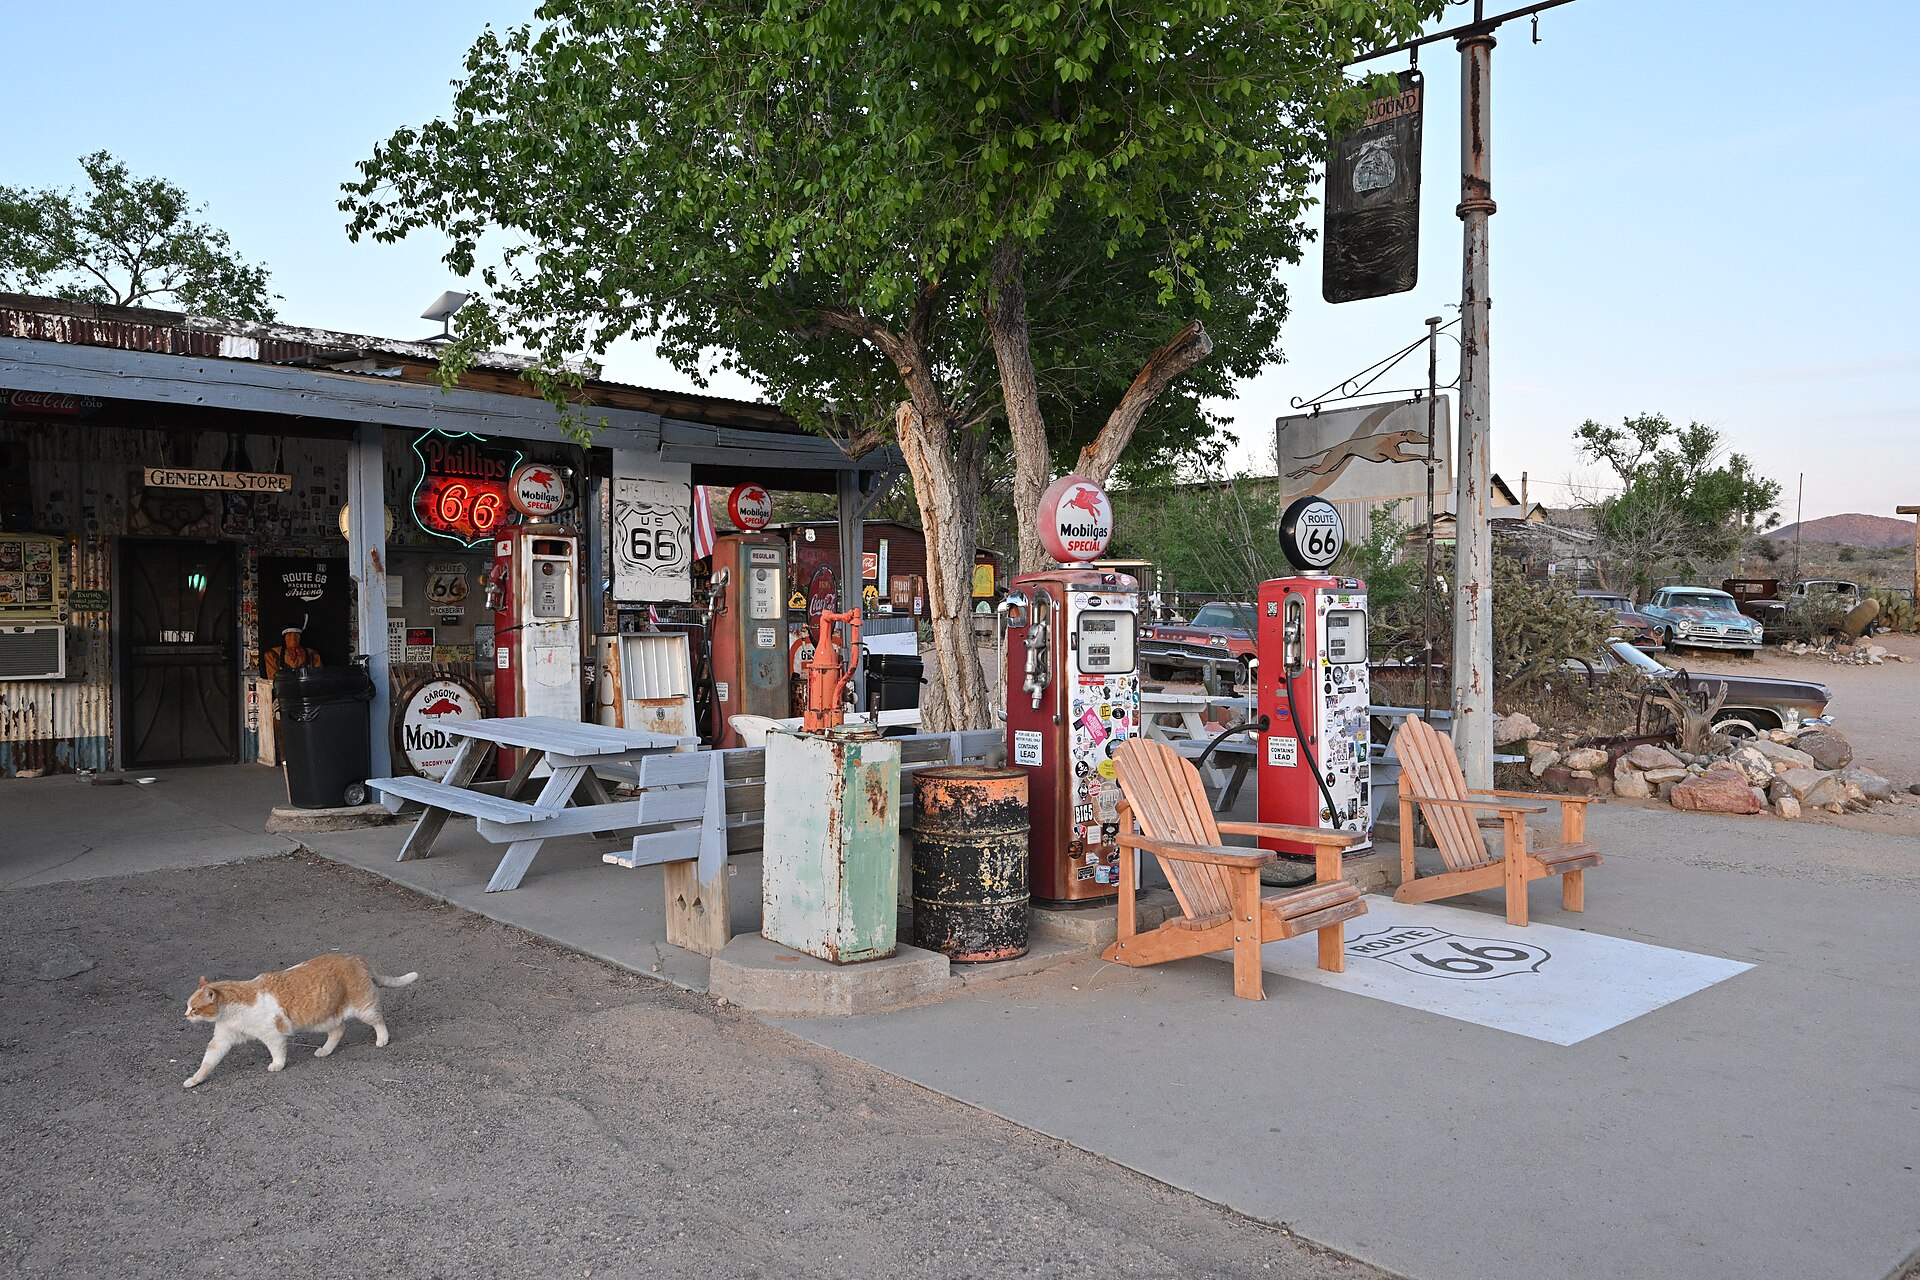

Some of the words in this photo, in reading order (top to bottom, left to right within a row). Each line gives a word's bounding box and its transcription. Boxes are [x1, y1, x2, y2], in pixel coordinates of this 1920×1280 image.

[425, 439, 505, 484] Phillips
[150, 469, 230, 487] GENERAL
[234, 473, 287, 489] STORE
[521, 490, 559, 503] Mobilgas
[437, 483, 500, 530] 66
[527, 501, 552, 511] SPECIAL
[740, 507, 769, 519] Mobilgas
[1308, 515, 1334, 523] ROUTE
[1060, 524, 1108, 541] Mobilgas
[631, 528, 676, 561] 66
[1067, 541, 1100, 551] SPECIAL
[1309, 528, 1336, 554] 66
[752, 552, 776, 560] REGULAR
[281, 572, 313, 583] ROUTE
[315, 573, 328, 584] 66
[434, 577, 463, 597] 66
[431, 607, 463, 615] HACKBERRY
[424, 689, 461, 704] GARGOYLE
[1020, 750, 1036, 758] LEAD
[1349, 930, 1433, 953] ROUTE
[1410, 942, 1530, 973] 66
